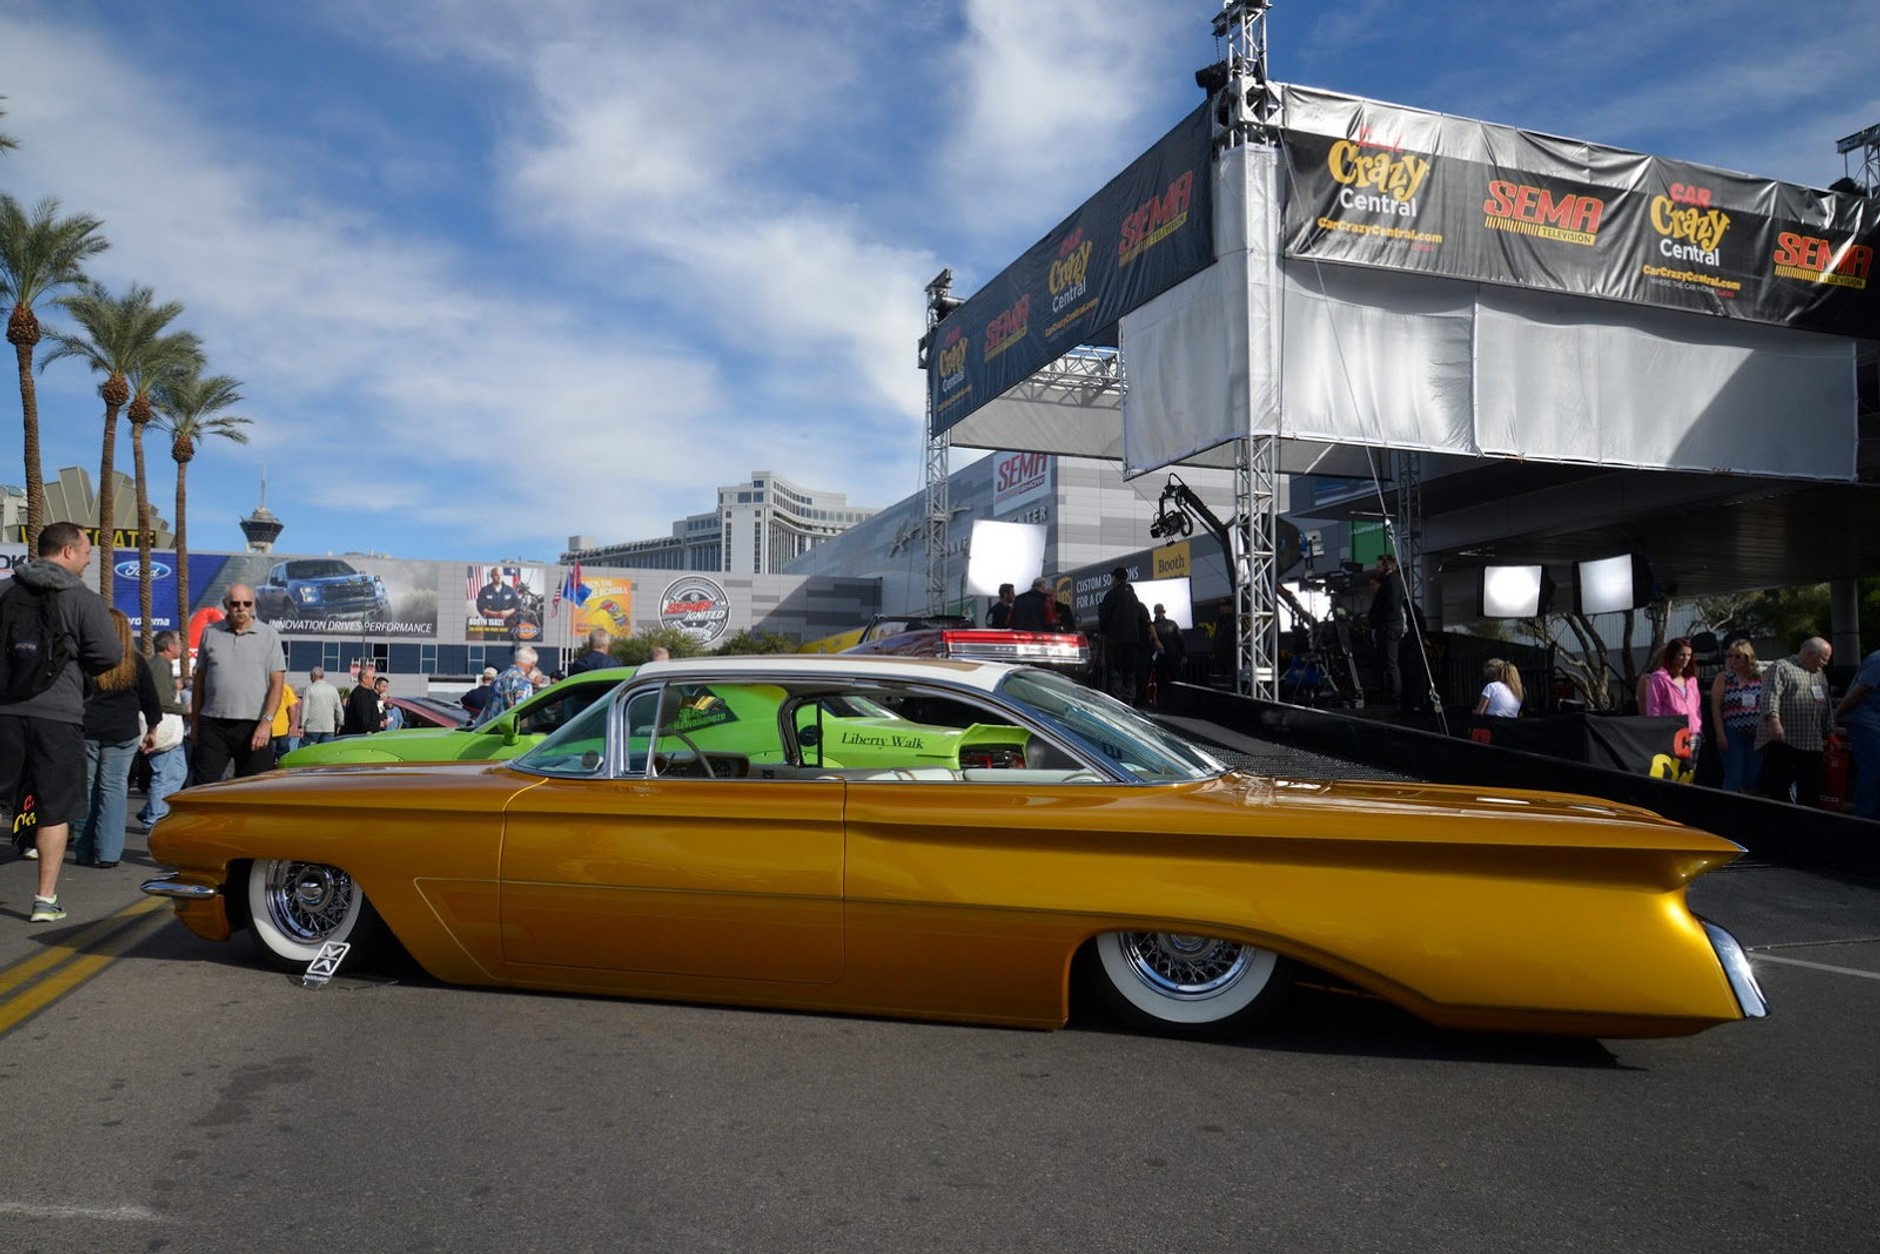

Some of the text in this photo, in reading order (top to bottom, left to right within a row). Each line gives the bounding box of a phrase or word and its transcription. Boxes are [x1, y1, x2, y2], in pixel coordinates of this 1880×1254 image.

[1328, 140, 1428, 202] Crazy
[1341, 187, 1417, 217] Central
[1483, 180, 1604, 234] SEMA
[1669, 182, 1712, 208] CAR
[1118, 170, 1193, 255] SEMA
[1650, 195, 1731, 253] Crazy
[1317, 216, 1443, 243] CarCrazyCentral.com
[1541, 226, 1592, 244] TELEVISION
[1660, 238, 1720, 266] Central
[1774, 231, 1874, 278] SEMA
[1048, 239, 1093, 296] Crazy
[1643, 264, 1741, 290] CarCrazyCentral.com
[1052, 276, 1086, 313] Central
[984, 293, 1030, 354] SEMA
[997, 453, 1049, 492] SEMA
[1158, 555, 1185, 574] Booth
[1076, 575, 1101, 594] CUSTOM
[663, 599, 713, 615] SEMA
[1076, 595, 1089, 610] FOR
[1089, 593, 1095, 607] A
[268, 618, 433, 634] INNOVATION DRIVES PERFORMANCE
[841, 732, 924, 749] Liberty Walk
